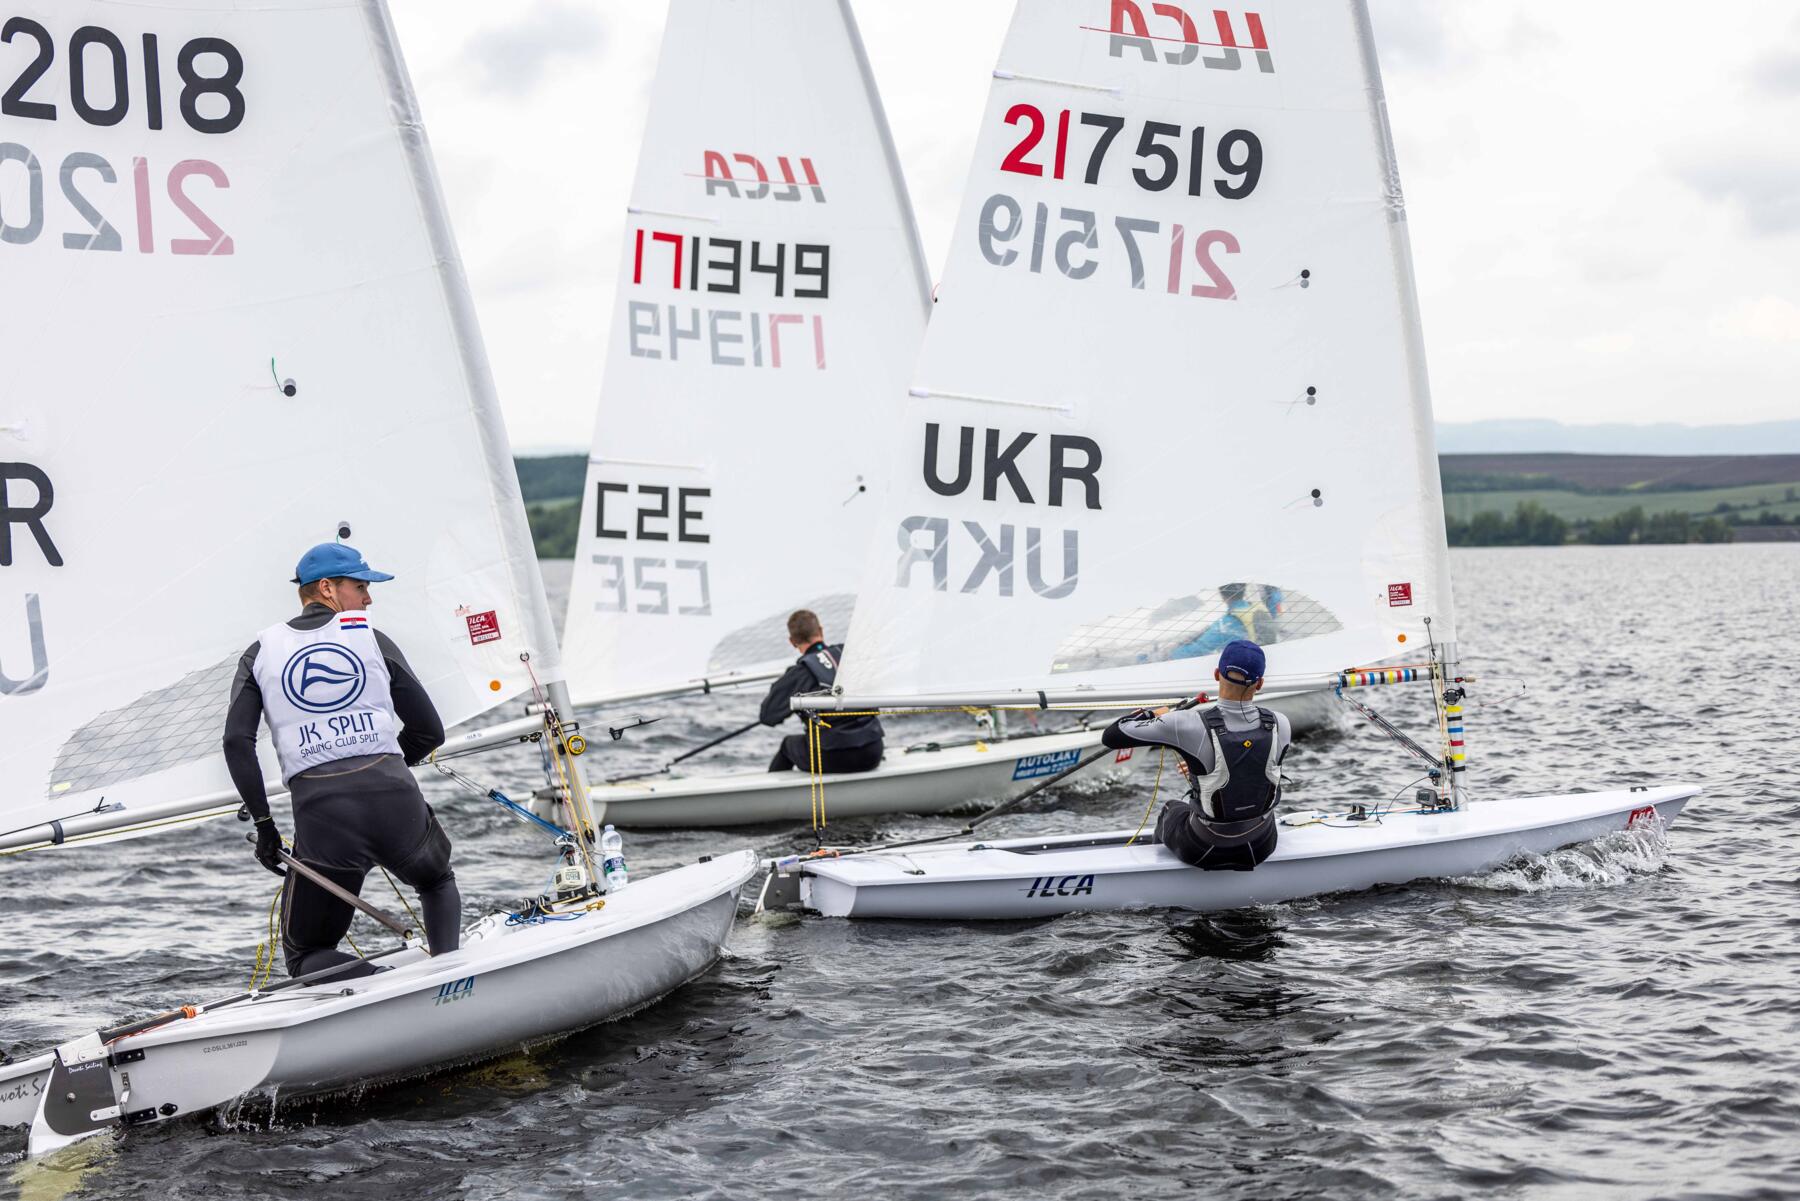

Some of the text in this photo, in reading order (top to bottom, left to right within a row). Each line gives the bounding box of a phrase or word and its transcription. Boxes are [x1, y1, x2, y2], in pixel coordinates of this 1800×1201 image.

[0, 16, 245, 134] 2018
[1000, 103, 1263, 200] 217519
[633, 229, 830, 299] 171349
[923, 422, 1103, 510] UKR
[298, 712, 374, 747] JK SPLIT
[300, 733, 379, 758] SAILING CLUB SPLIT
[1027, 874, 1095, 898] ILCA
[435, 976, 474, 1006] ILCA
